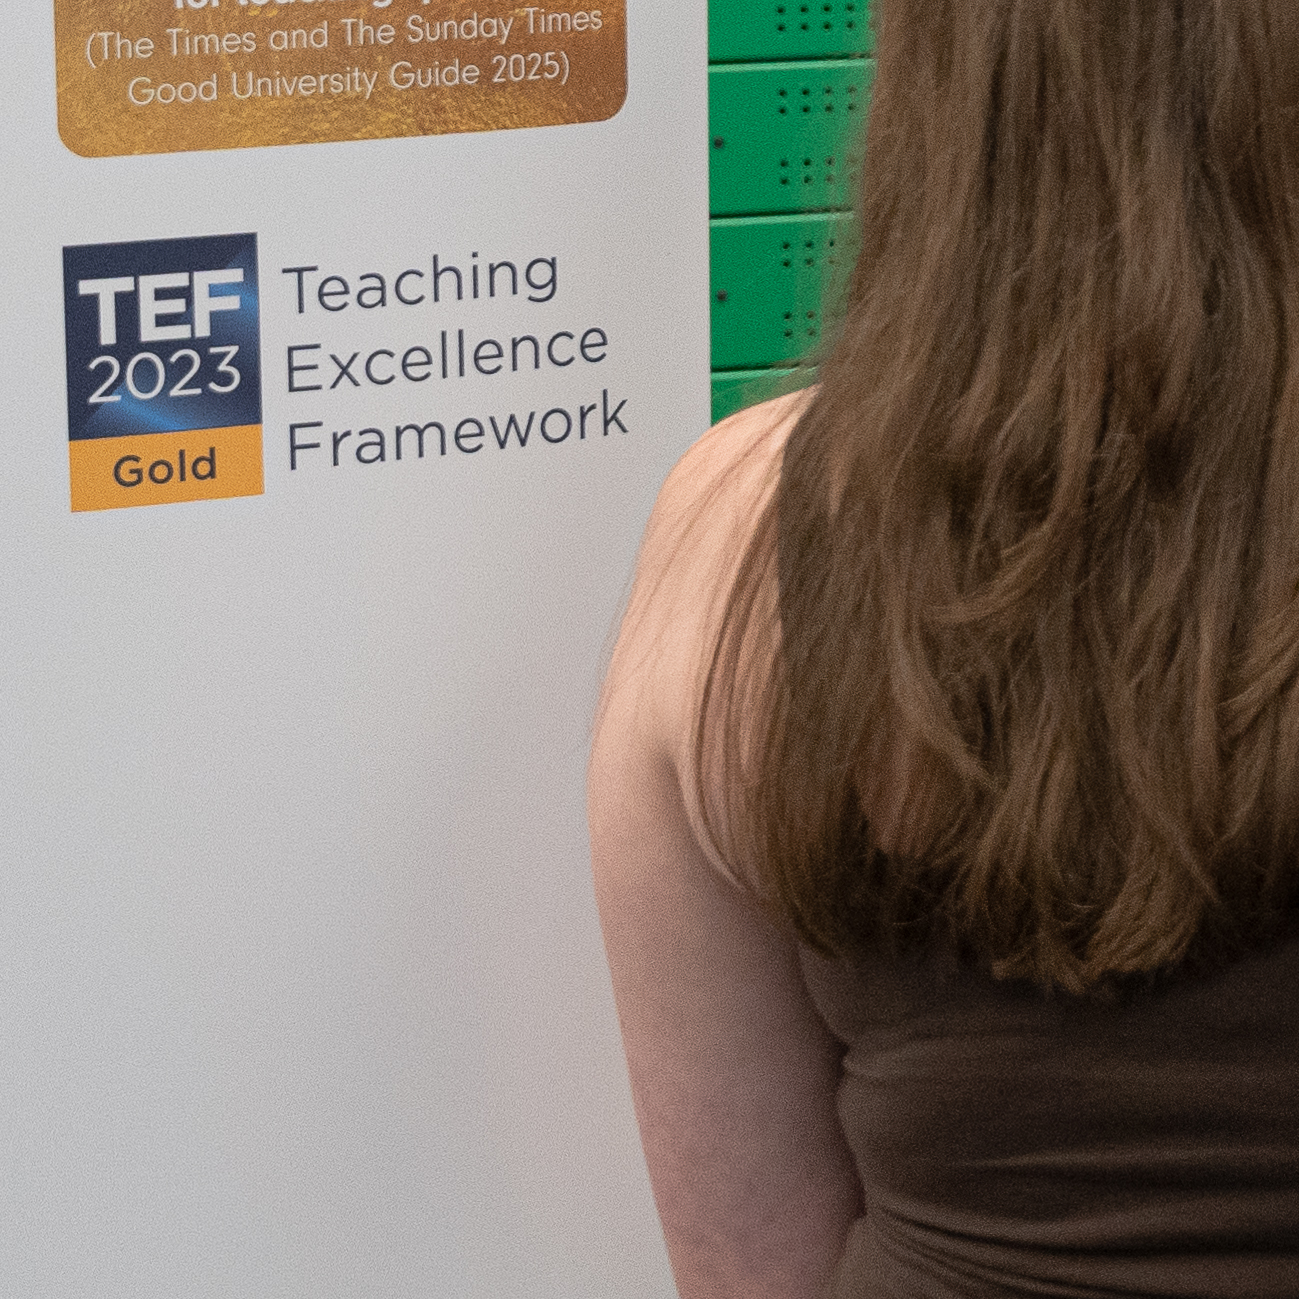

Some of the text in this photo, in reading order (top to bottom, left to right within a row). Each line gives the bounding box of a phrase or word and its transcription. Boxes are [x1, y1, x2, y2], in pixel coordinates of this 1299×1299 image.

[86, 5, 603, 68] (The Times and The Sunday Times
[127, 51, 571, 106] Good University Guide 2025)
[79, 267, 245, 348] TEF
[282, 252, 558, 315] Teaching
[88, 346, 242, 404] 2023
[287, 327, 609, 394] Excellence
[288, 389, 629, 471] Framework
[112, 446, 218, 488] Gold
